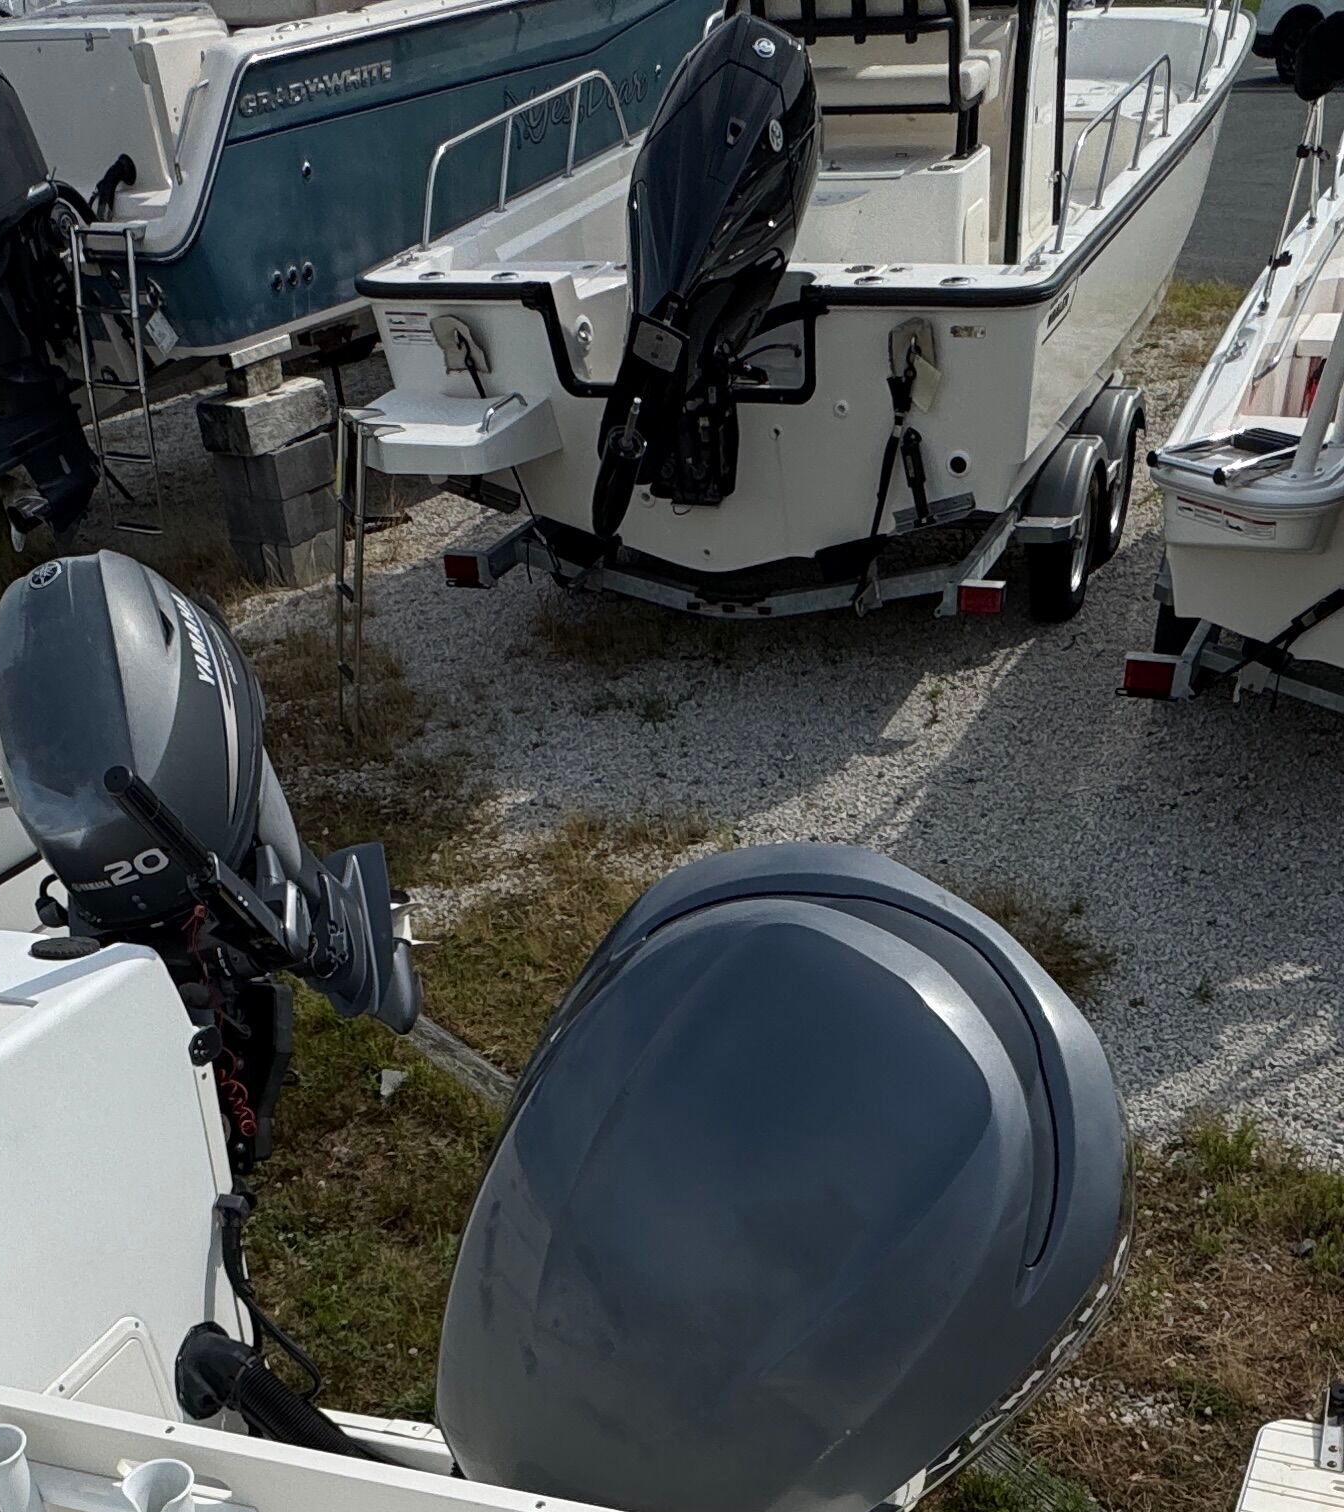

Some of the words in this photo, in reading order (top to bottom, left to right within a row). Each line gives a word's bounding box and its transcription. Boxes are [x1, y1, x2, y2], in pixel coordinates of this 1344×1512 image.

[239, 59, 392, 118] GRADY-WHITE
[170, 592, 216, 687] YAMAHA
[104, 847, 169, 887] 20
